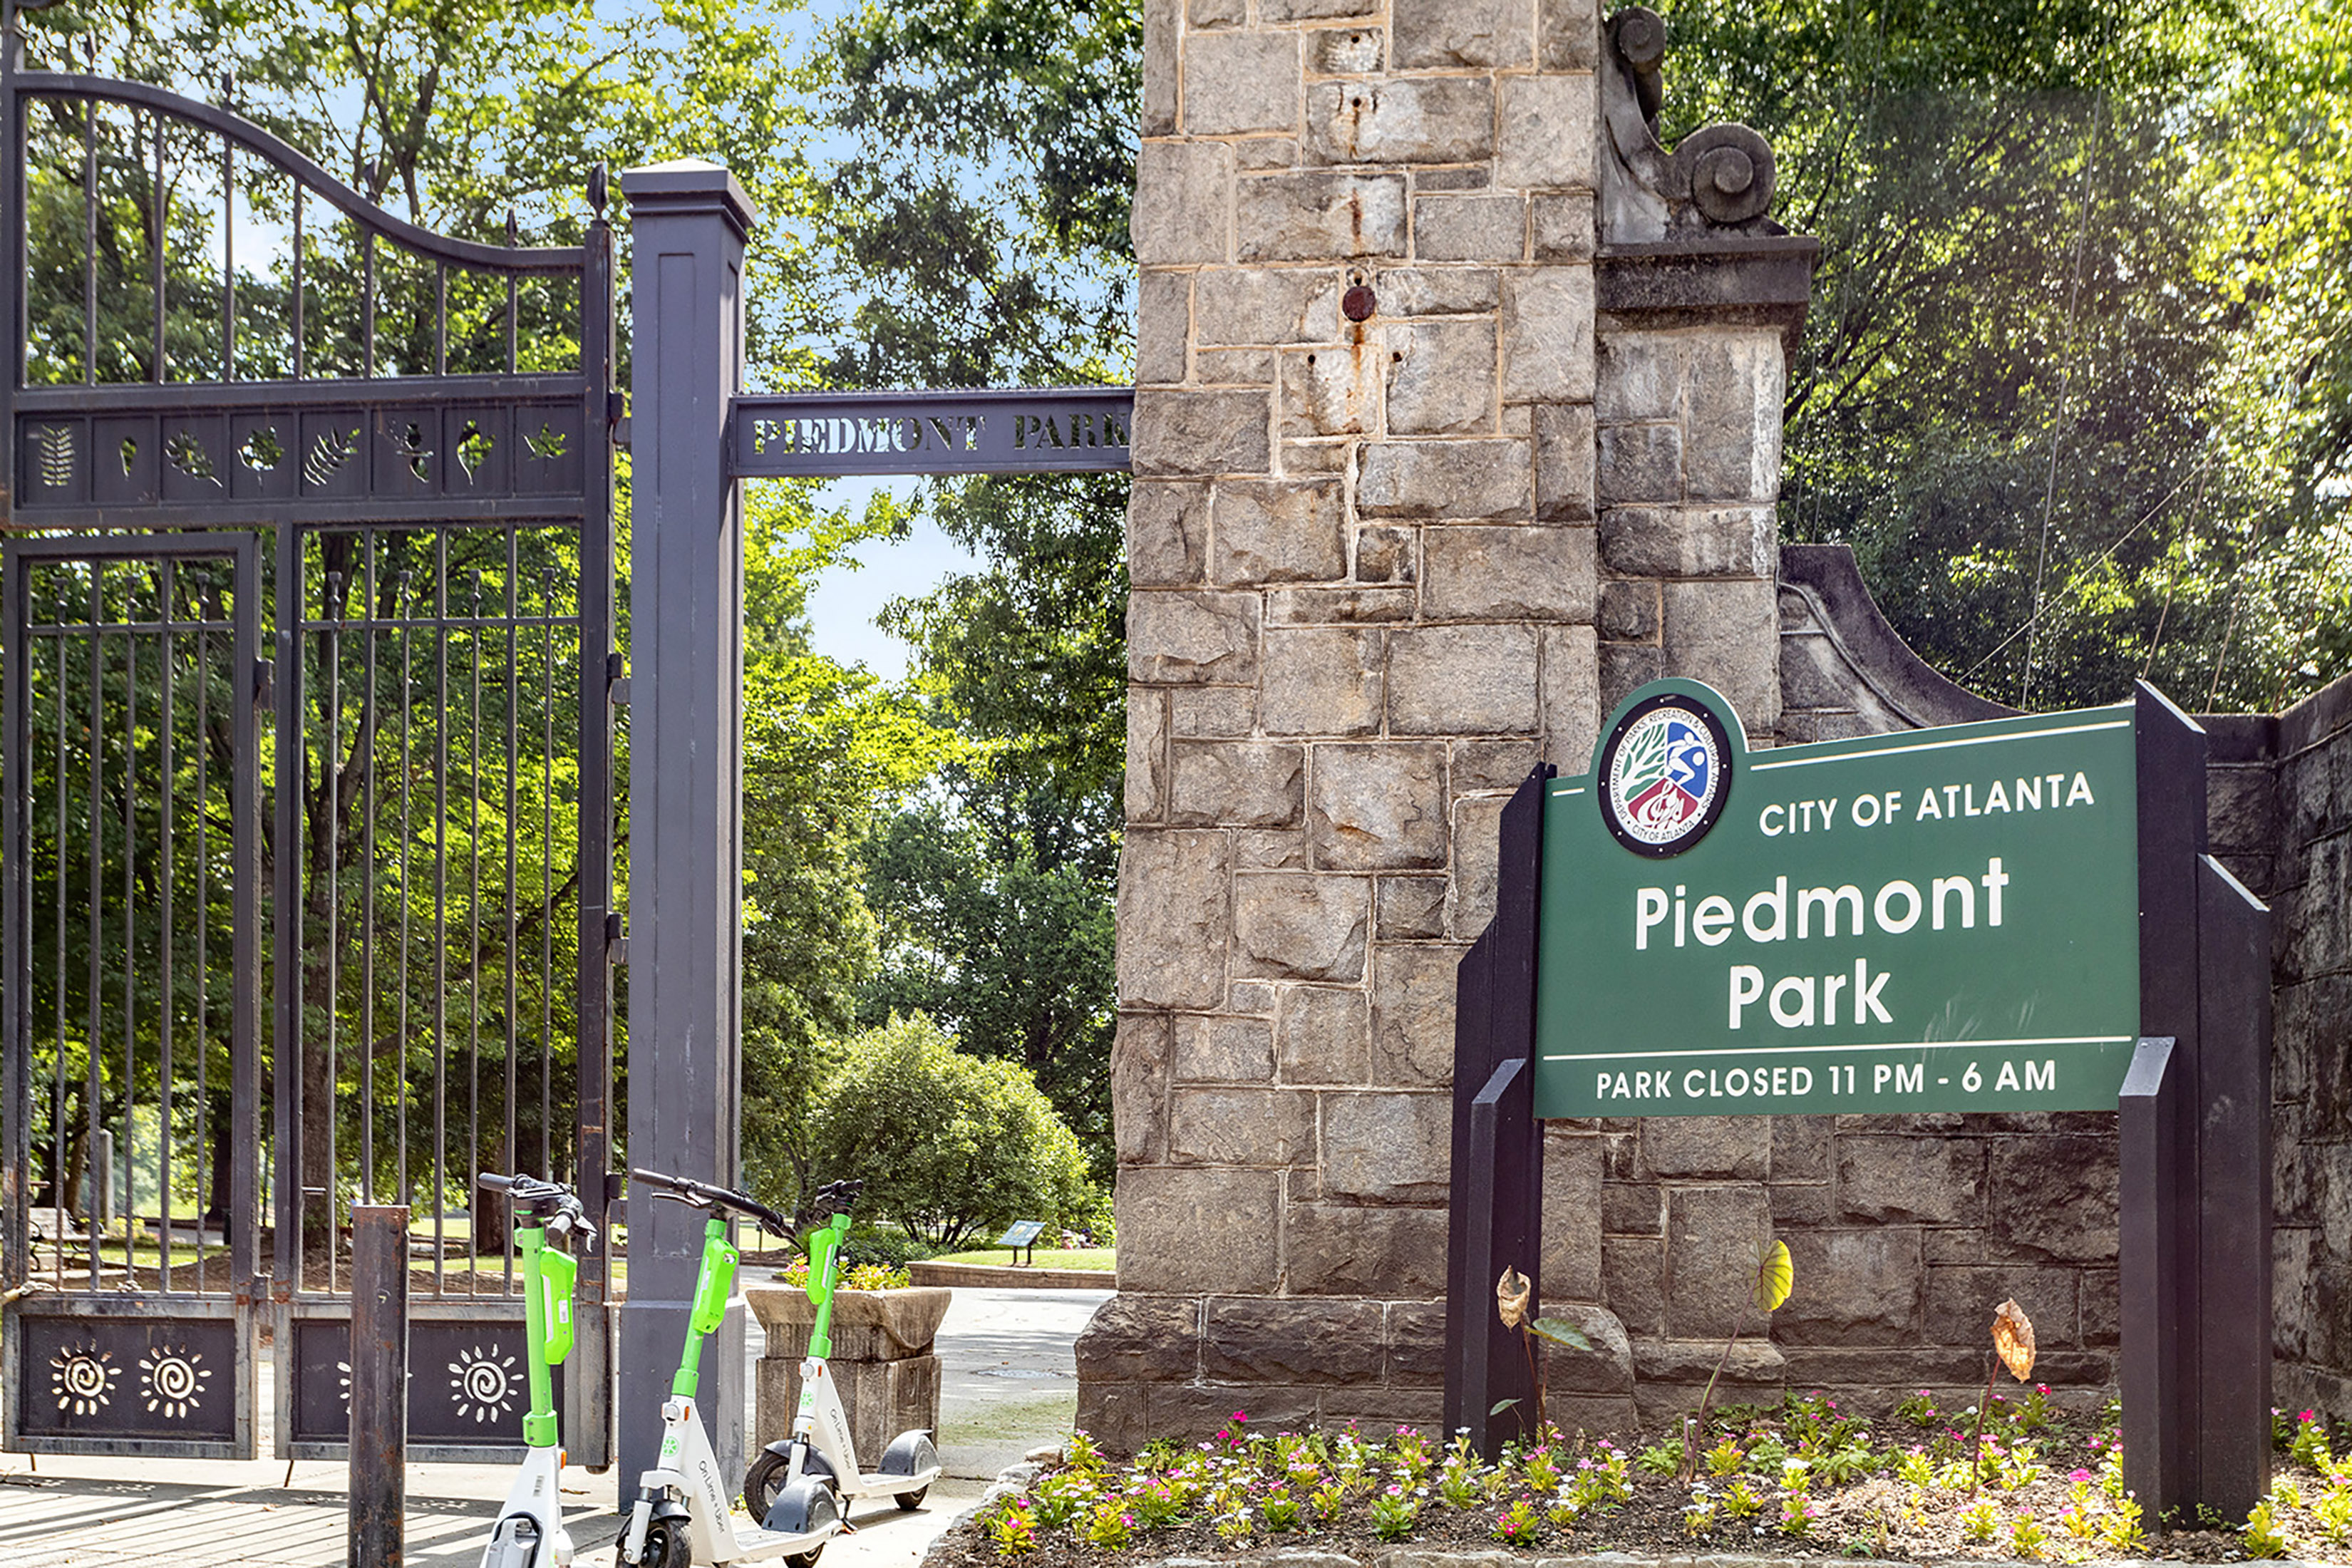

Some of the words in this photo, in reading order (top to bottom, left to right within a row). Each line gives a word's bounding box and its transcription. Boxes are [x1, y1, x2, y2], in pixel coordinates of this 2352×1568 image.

[753, 416, 986, 455] PIEDMONT
[1013, 413, 1131, 450] PARK
[1618, 742, 1628, 758] OF
[1612, 758, 1628, 820] DEPARTMENT
[1759, 798, 1838, 837] CITY
[1852, 791, 1902, 827] OF
[1916, 772, 2095, 821] ATLANTA
[1631, 825, 1649, 839] CITY
[1649, 831, 1660, 841] OF
[1661, 820, 1695, 841] ATLANTA
[1636, 857, 2009, 950] Piedmont
[1729, 958, 1894, 1029] Park
[1597, 1071, 1672, 1099] PARK
[1683, 1067, 1813, 1098] CLOSED
[1828, 1066, 1855, 1095] 11
[1874, 1063, 1924, 1094] PM
[1961, 1062, 1982, 1093] 6
[1994, 1060, 2056, 1091] AM
